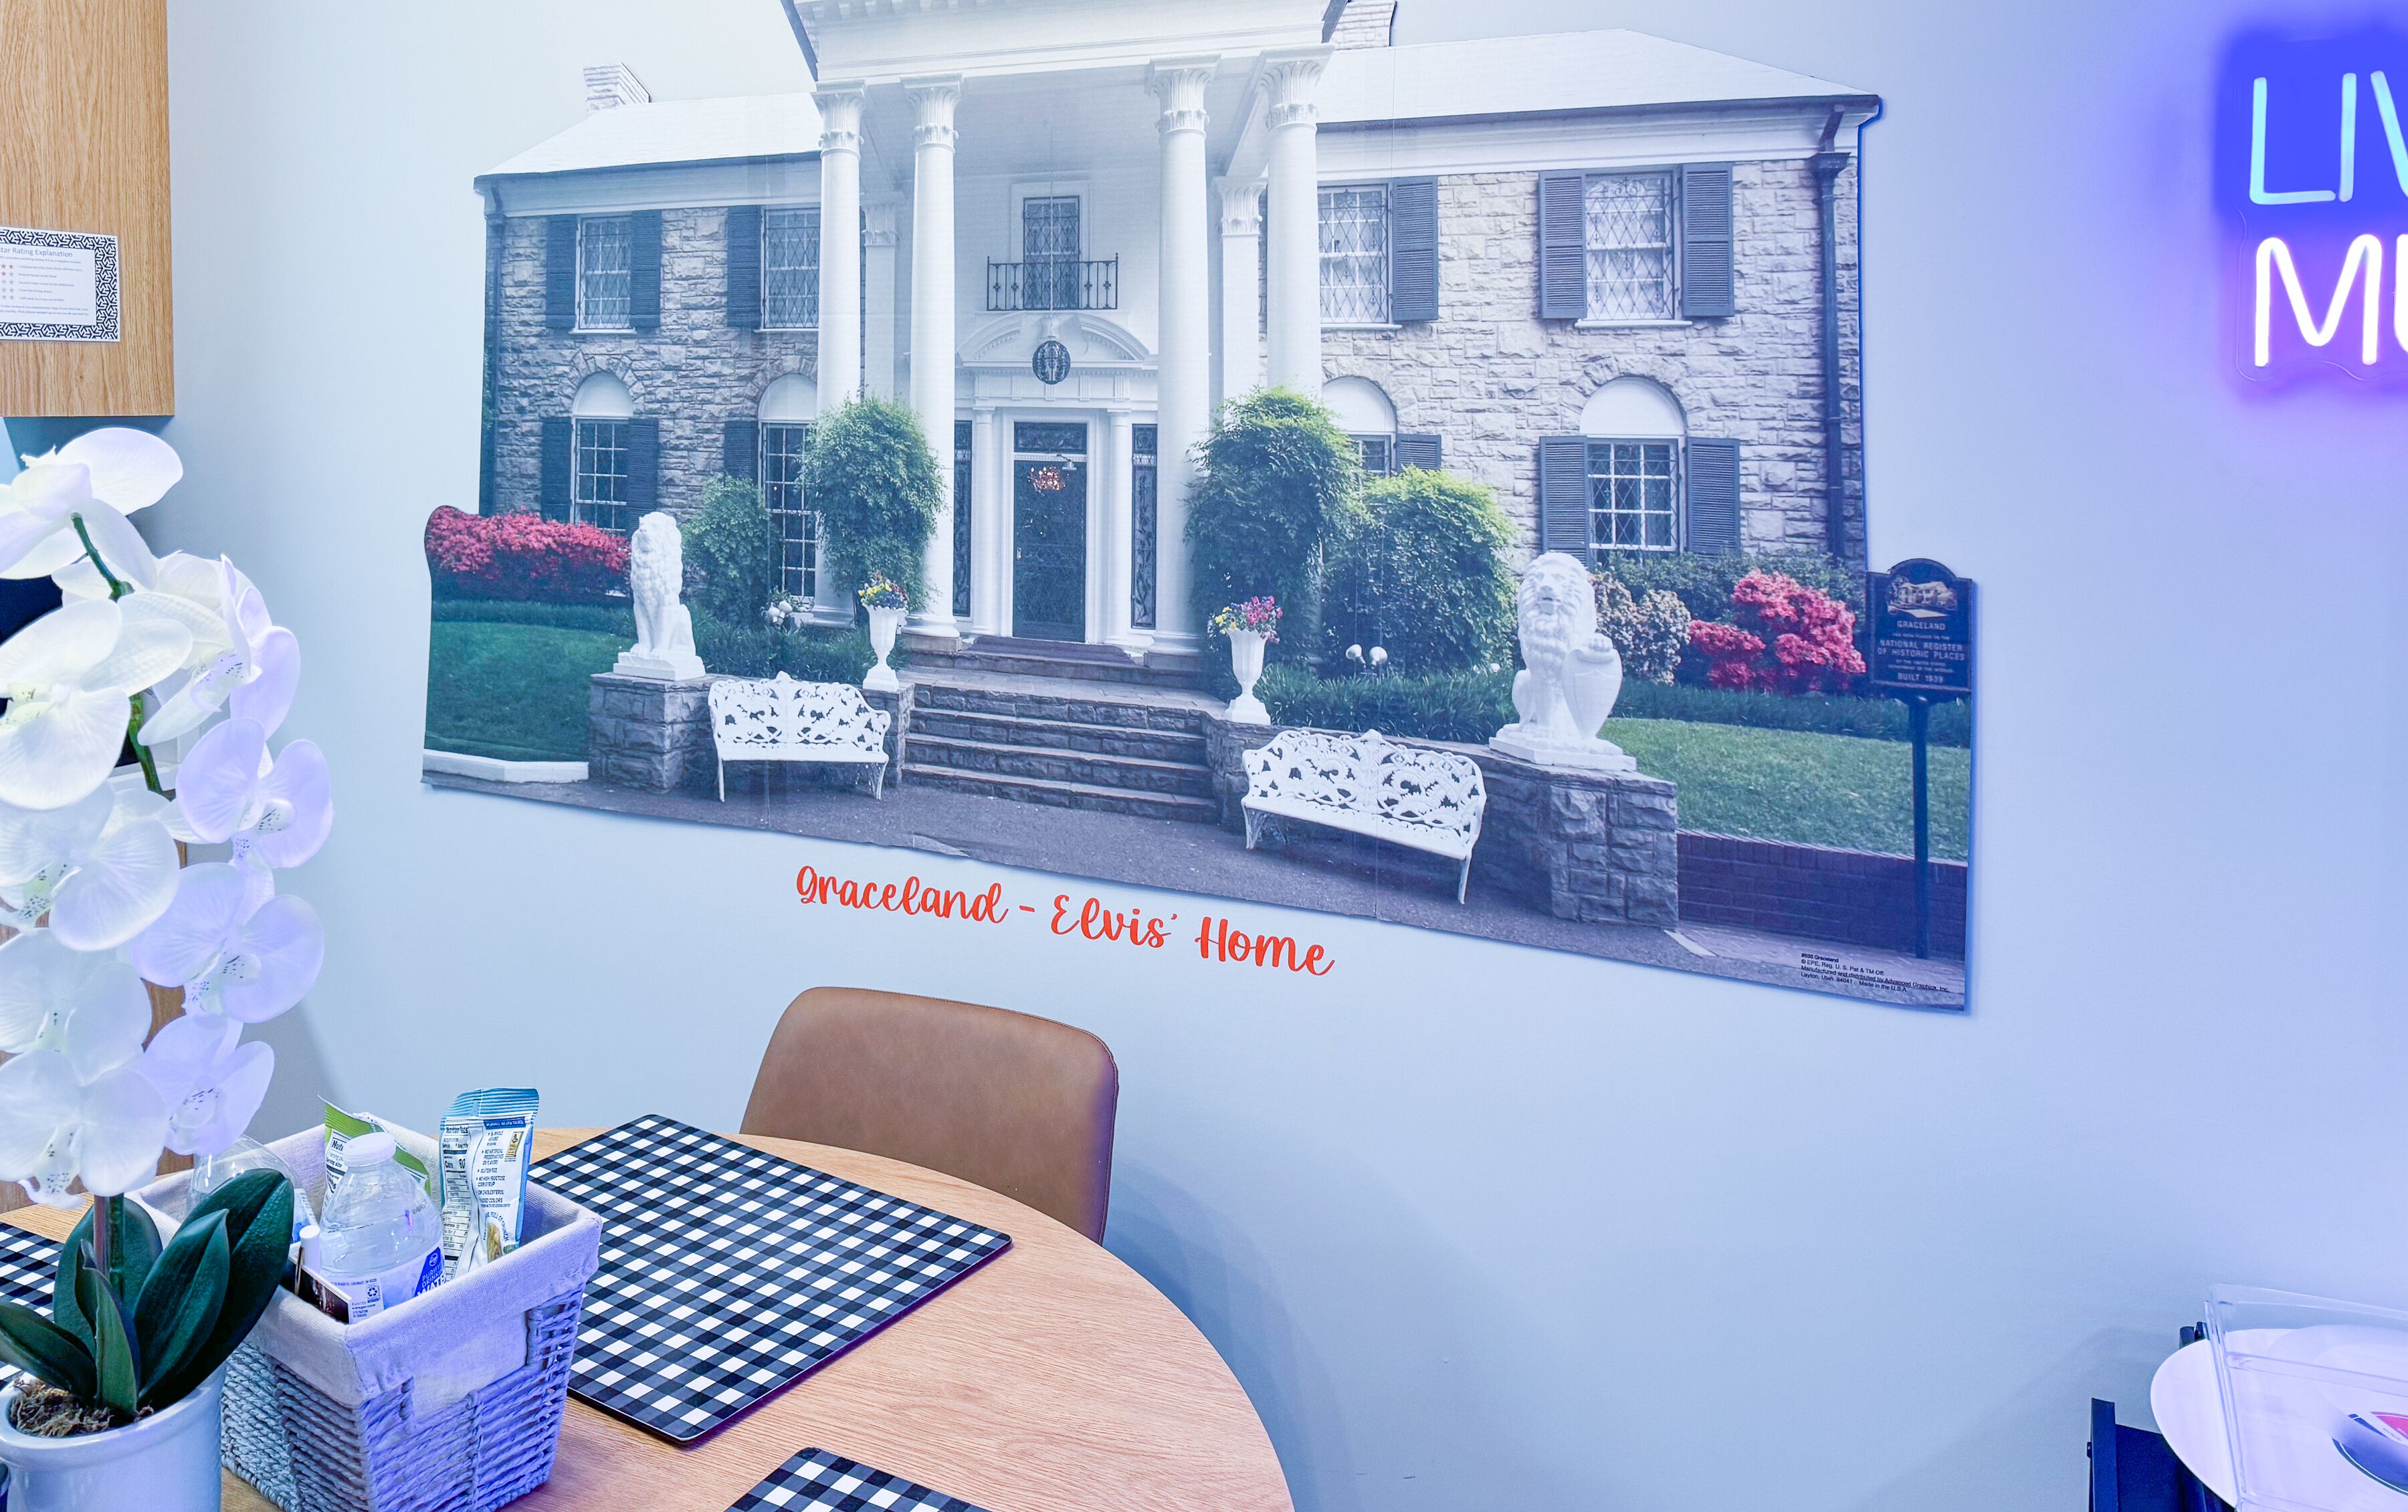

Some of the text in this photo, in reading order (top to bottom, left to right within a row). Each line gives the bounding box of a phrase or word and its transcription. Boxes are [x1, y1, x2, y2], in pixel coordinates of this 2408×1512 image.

[35, 248, 73, 257] Explanation
[2255, 233, 2408, 367] M
[1897, 621, 1946, 630] GRACELAND
[1880, 639, 1963, 651] NATIONAL REGISTER
[1892, 649, 1929, 658] HISTORIC
[1934, 651, 1965, 661] PLACES
[1898, 673, 1920, 681] BUILT
[1195, 917, 1335, 976] Home
[1814, 955, 1839, 963] Graceland
[1801, 966, 1837, 976] Manufactured
[1848, 973, 1876, 982] distributed
[1884, 978, 1911, 987] Advanced
